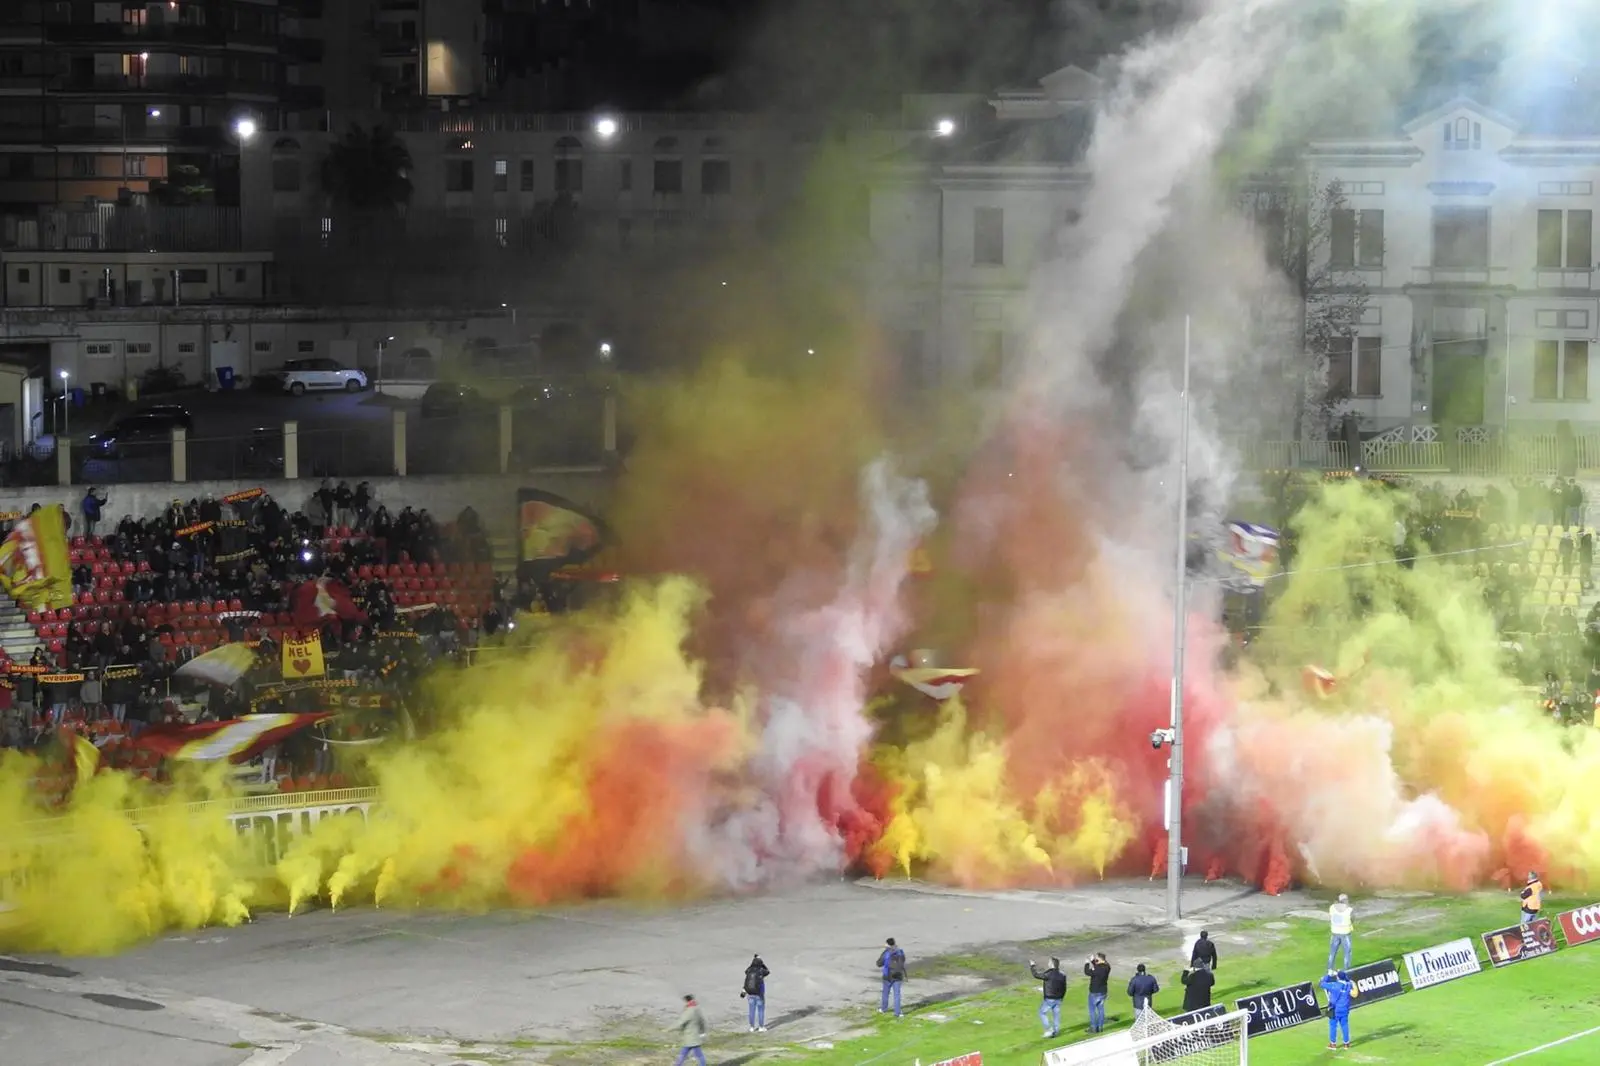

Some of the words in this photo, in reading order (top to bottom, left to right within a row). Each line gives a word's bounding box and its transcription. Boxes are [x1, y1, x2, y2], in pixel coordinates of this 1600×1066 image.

[288, 647, 313, 658] NEL
[1410, 956, 1423, 977] le
[1421, 949, 1471, 973] Fontane
[1260, 996, 1273, 1020] A
[1273, 997, 1285, 1016] &
[1282, 990, 1296, 1012] D
